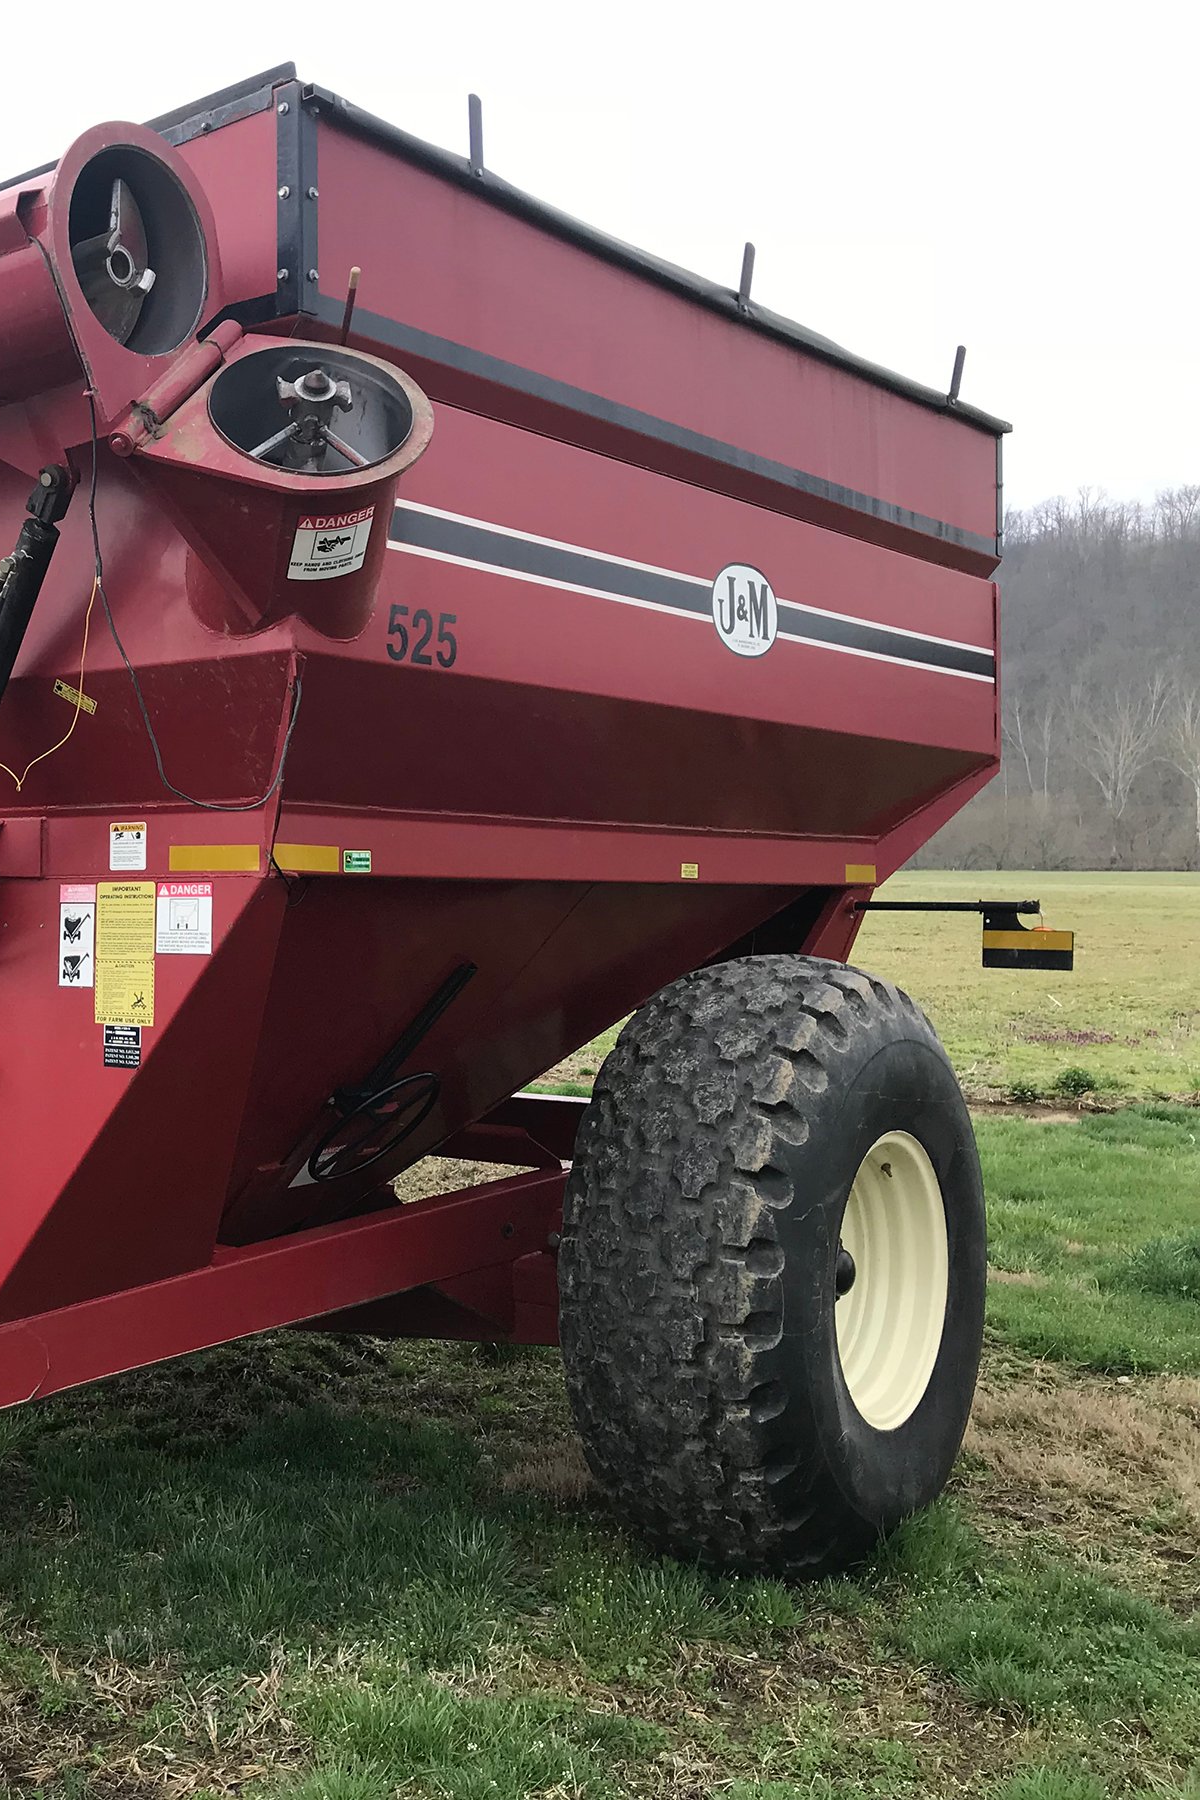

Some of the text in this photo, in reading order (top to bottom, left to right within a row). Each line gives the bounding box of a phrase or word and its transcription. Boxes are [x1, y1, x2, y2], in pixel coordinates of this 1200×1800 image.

[315, 506, 375, 529] DANGER
[717, 575, 771, 641] J&M
[386, 604, 458, 668] 525
[170, 884, 212, 895] DANGER
